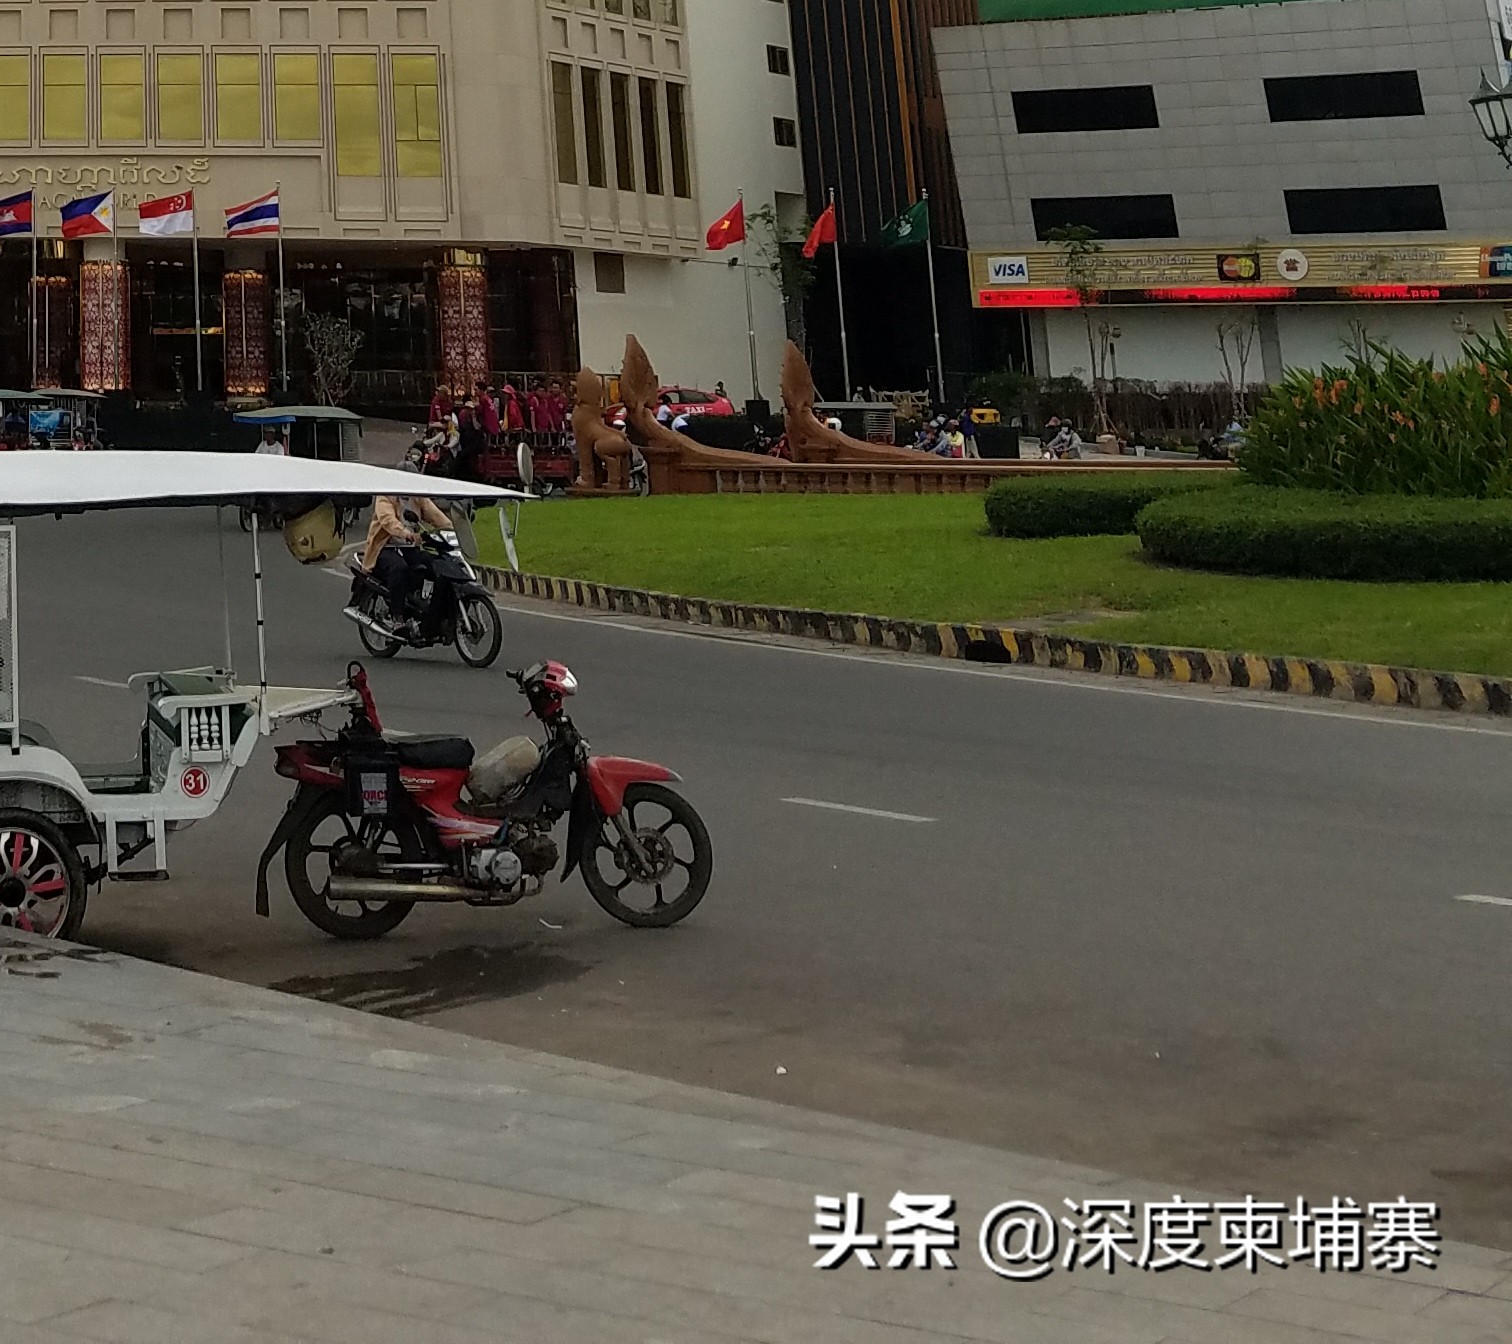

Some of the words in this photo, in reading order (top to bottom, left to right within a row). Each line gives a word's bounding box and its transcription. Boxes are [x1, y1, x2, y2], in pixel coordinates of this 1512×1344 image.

[994, 263, 1025, 277] VISA
[685, 406, 706, 414] TAXI
[185, 773, 204, 790] 31
